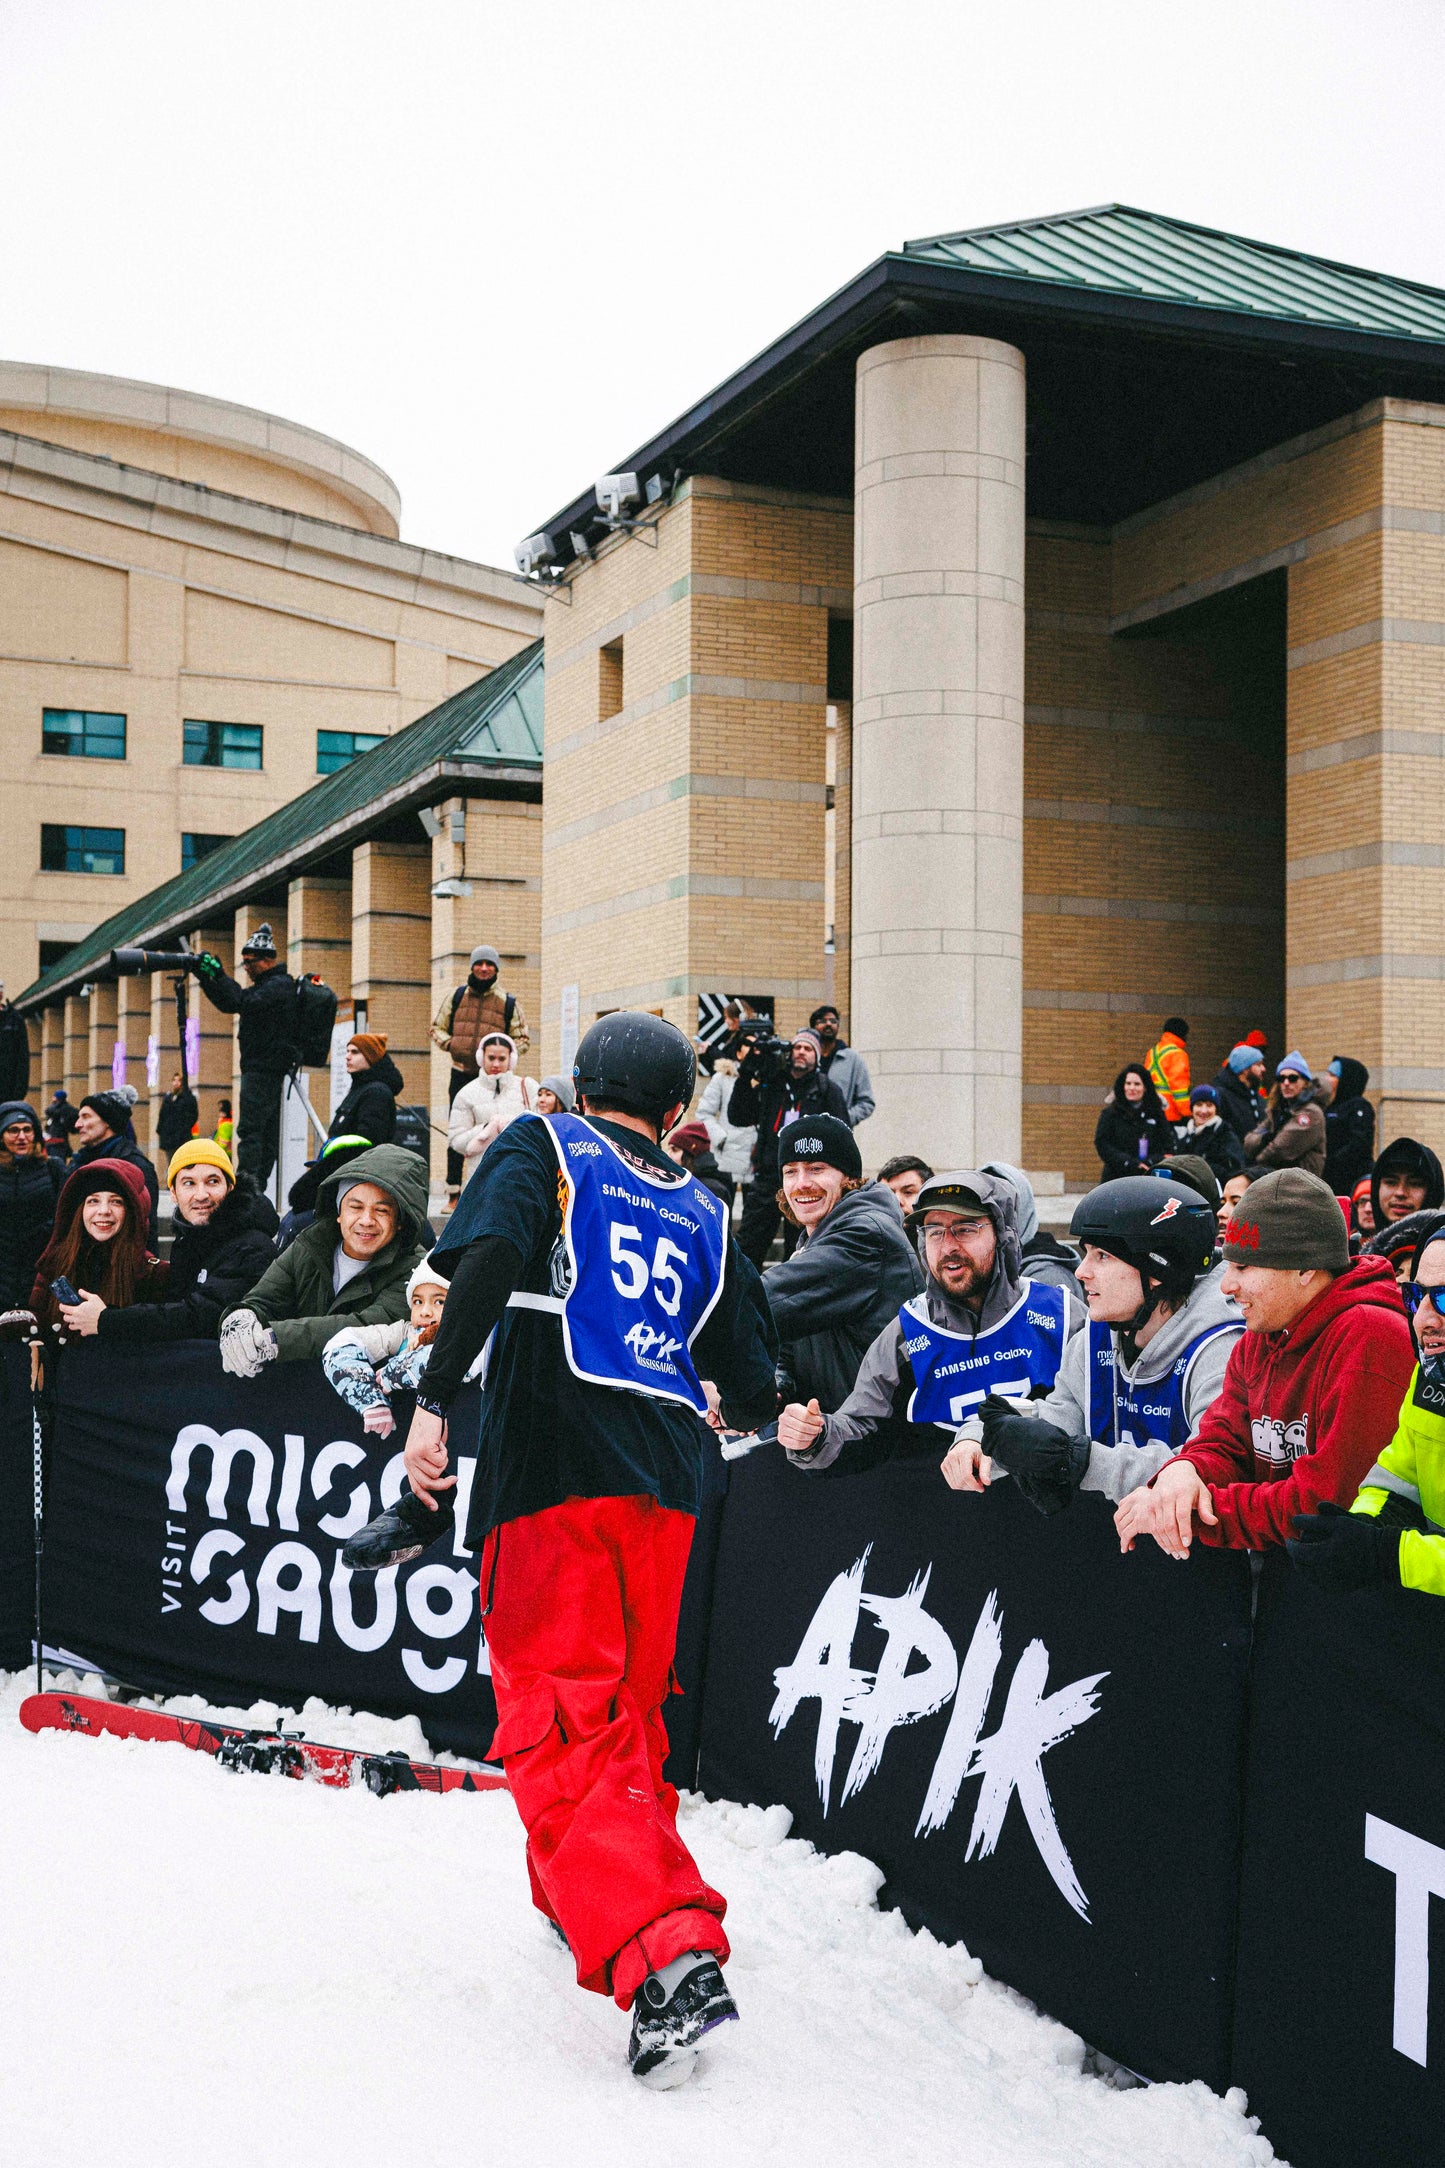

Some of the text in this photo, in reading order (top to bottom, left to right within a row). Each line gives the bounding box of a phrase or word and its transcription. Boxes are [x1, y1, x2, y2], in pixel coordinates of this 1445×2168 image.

[659, 1207, 700, 1235] Galaxy
[610, 1221, 688, 1316] 55
[934, 1348, 1032, 1379] SAMSUNG Galaxy
[1422, 1385, 1445, 1406] OD
[161, 1521, 187, 1614] VISIT
[1364, 1812, 1445, 2068] T
